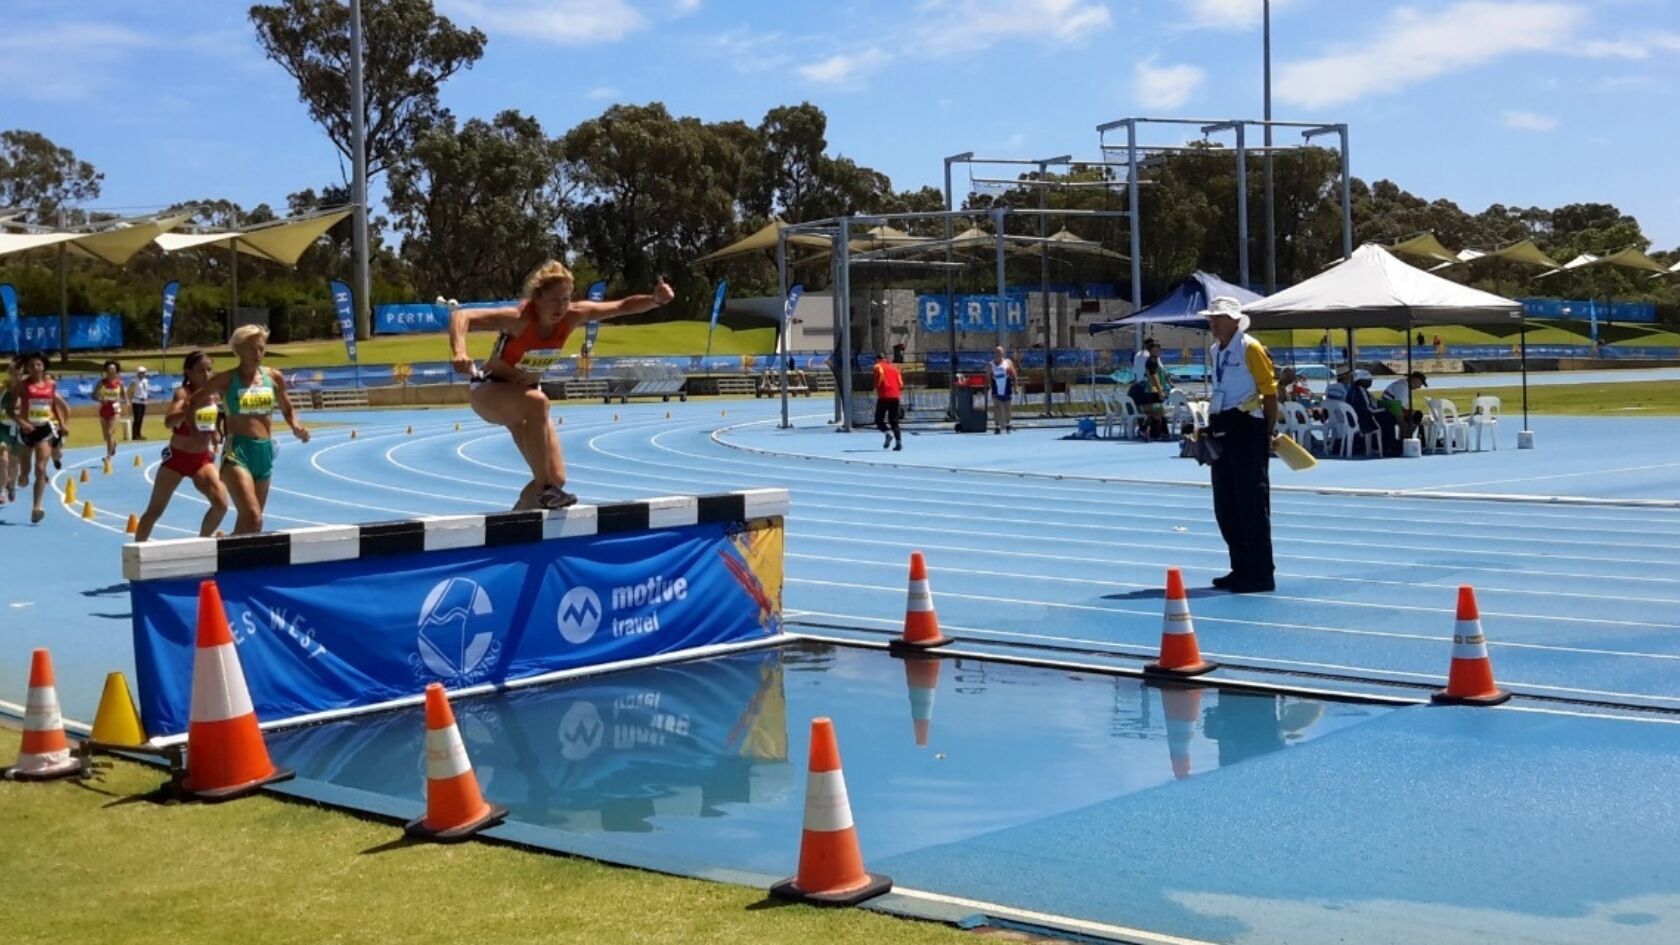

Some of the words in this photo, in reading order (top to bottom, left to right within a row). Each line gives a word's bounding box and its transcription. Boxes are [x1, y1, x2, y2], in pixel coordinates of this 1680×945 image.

[335, 292, 357, 355] PERTH
[386, 312, 435, 324] PERTH
[612, 575, 688, 610] motive
[270, 607, 326, 658] WEST
[612, 612, 660, 637] travel
